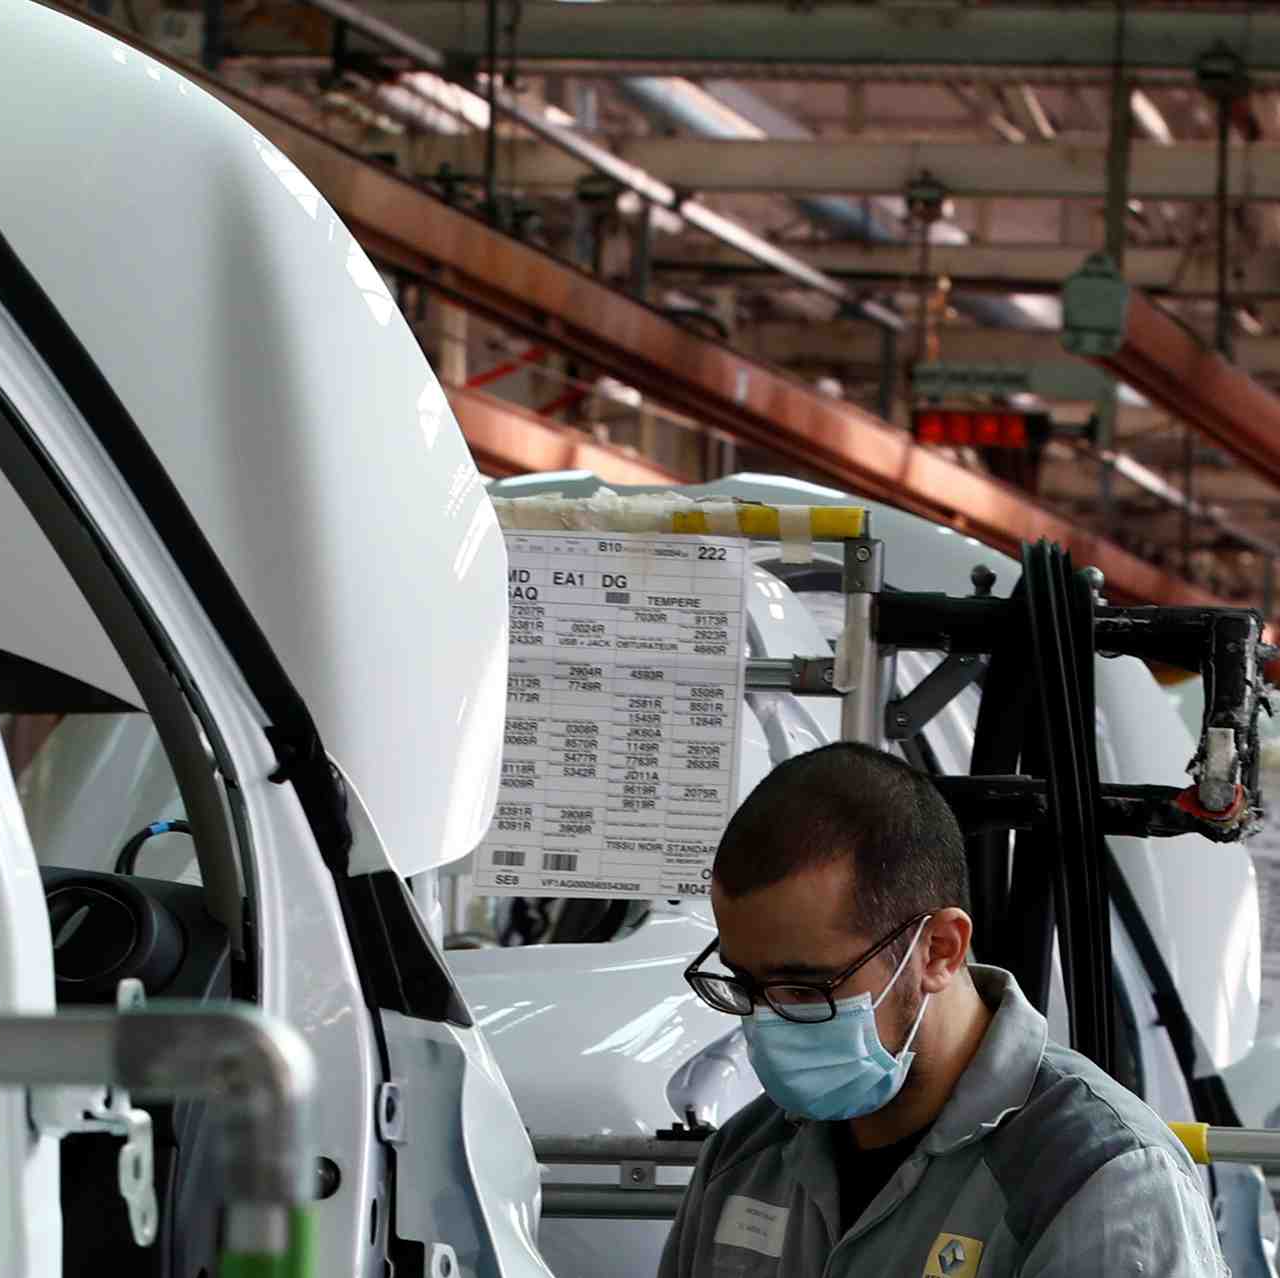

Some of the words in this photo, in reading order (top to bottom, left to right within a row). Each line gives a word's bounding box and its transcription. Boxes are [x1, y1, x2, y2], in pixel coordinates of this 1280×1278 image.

[698, 546, 727, 561] 222
[553, 571, 584, 586] EA1
[601, 574, 627, 588] DG
[647, 596, 702, 608] TEMPERE
